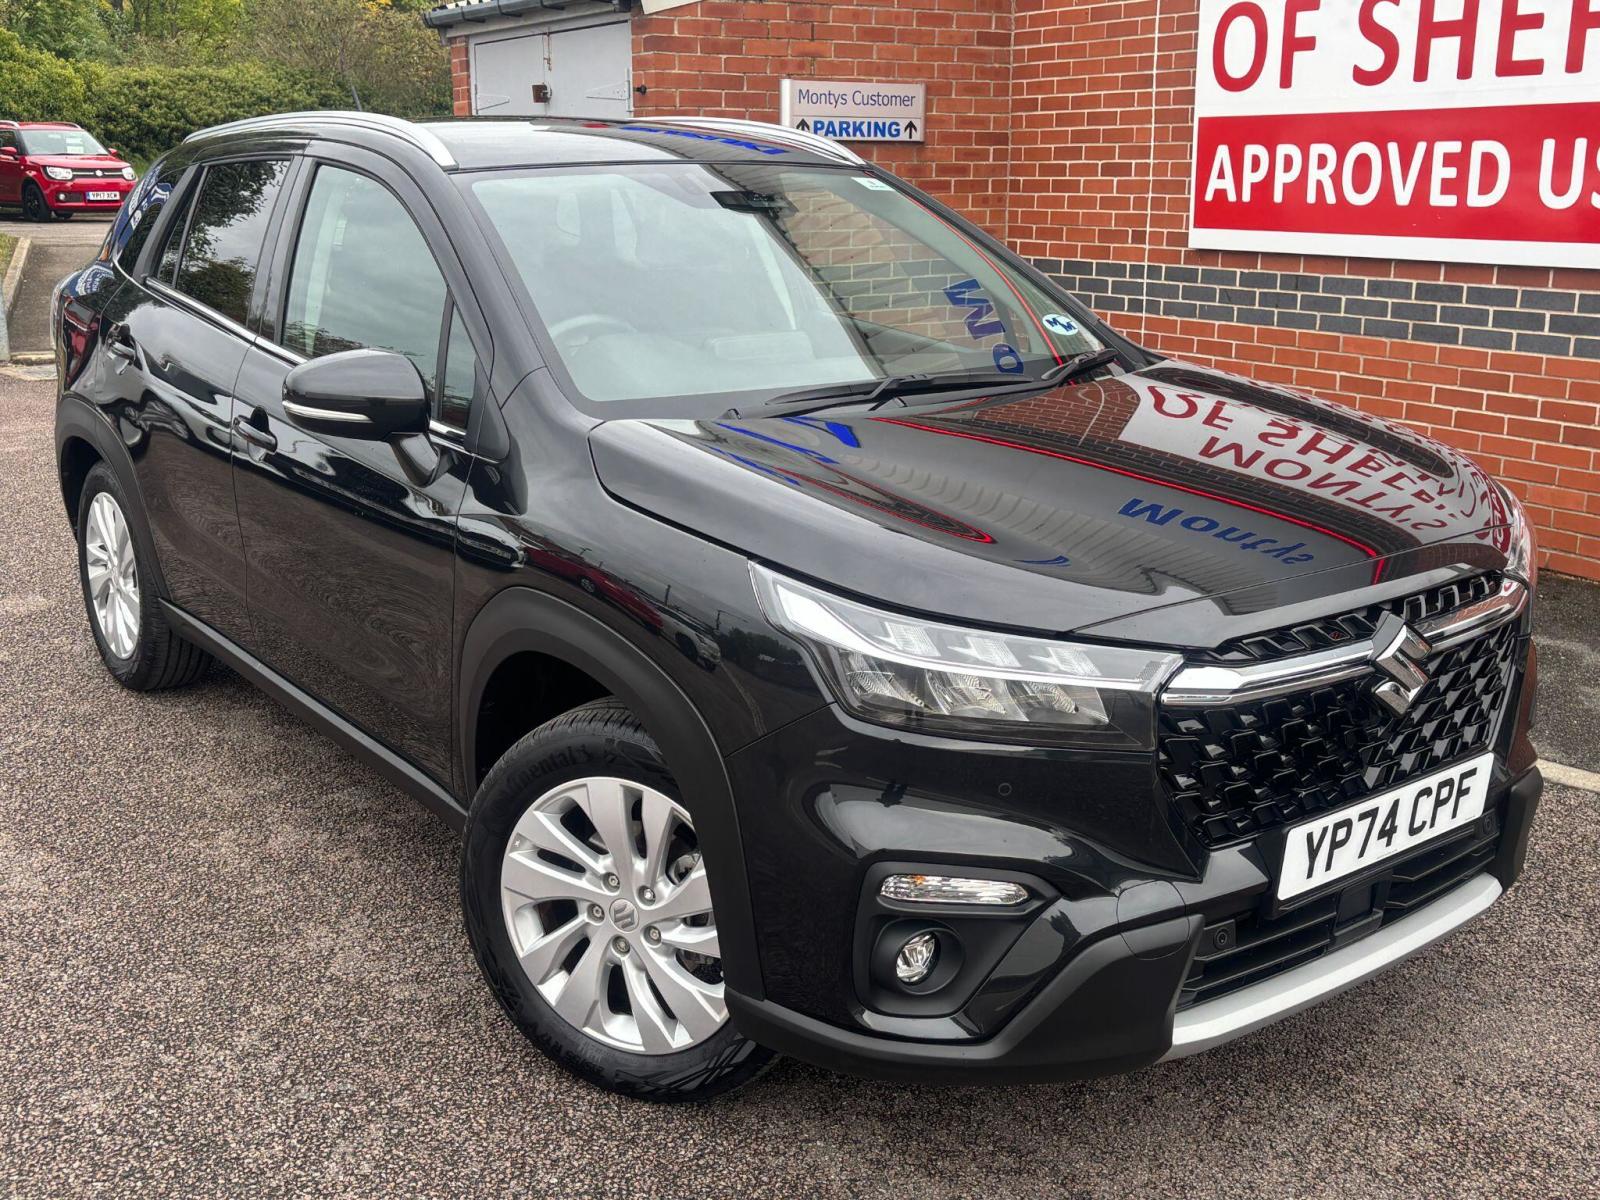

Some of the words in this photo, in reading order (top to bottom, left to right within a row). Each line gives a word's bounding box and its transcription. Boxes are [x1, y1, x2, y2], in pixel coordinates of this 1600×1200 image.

[1212, 0, 1321, 92] OF
[798, 89, 848, 108] Montys
[852, 90, 916, 107] Customer
[813, 119, 901, 138] PARKING
[1204, 139, 1511, 208] APPROVED
[1538, 137, 1600, 210] U
[1305, 798, 1401, 880] YP74
[1407, 766, 1479, 838] CPF
